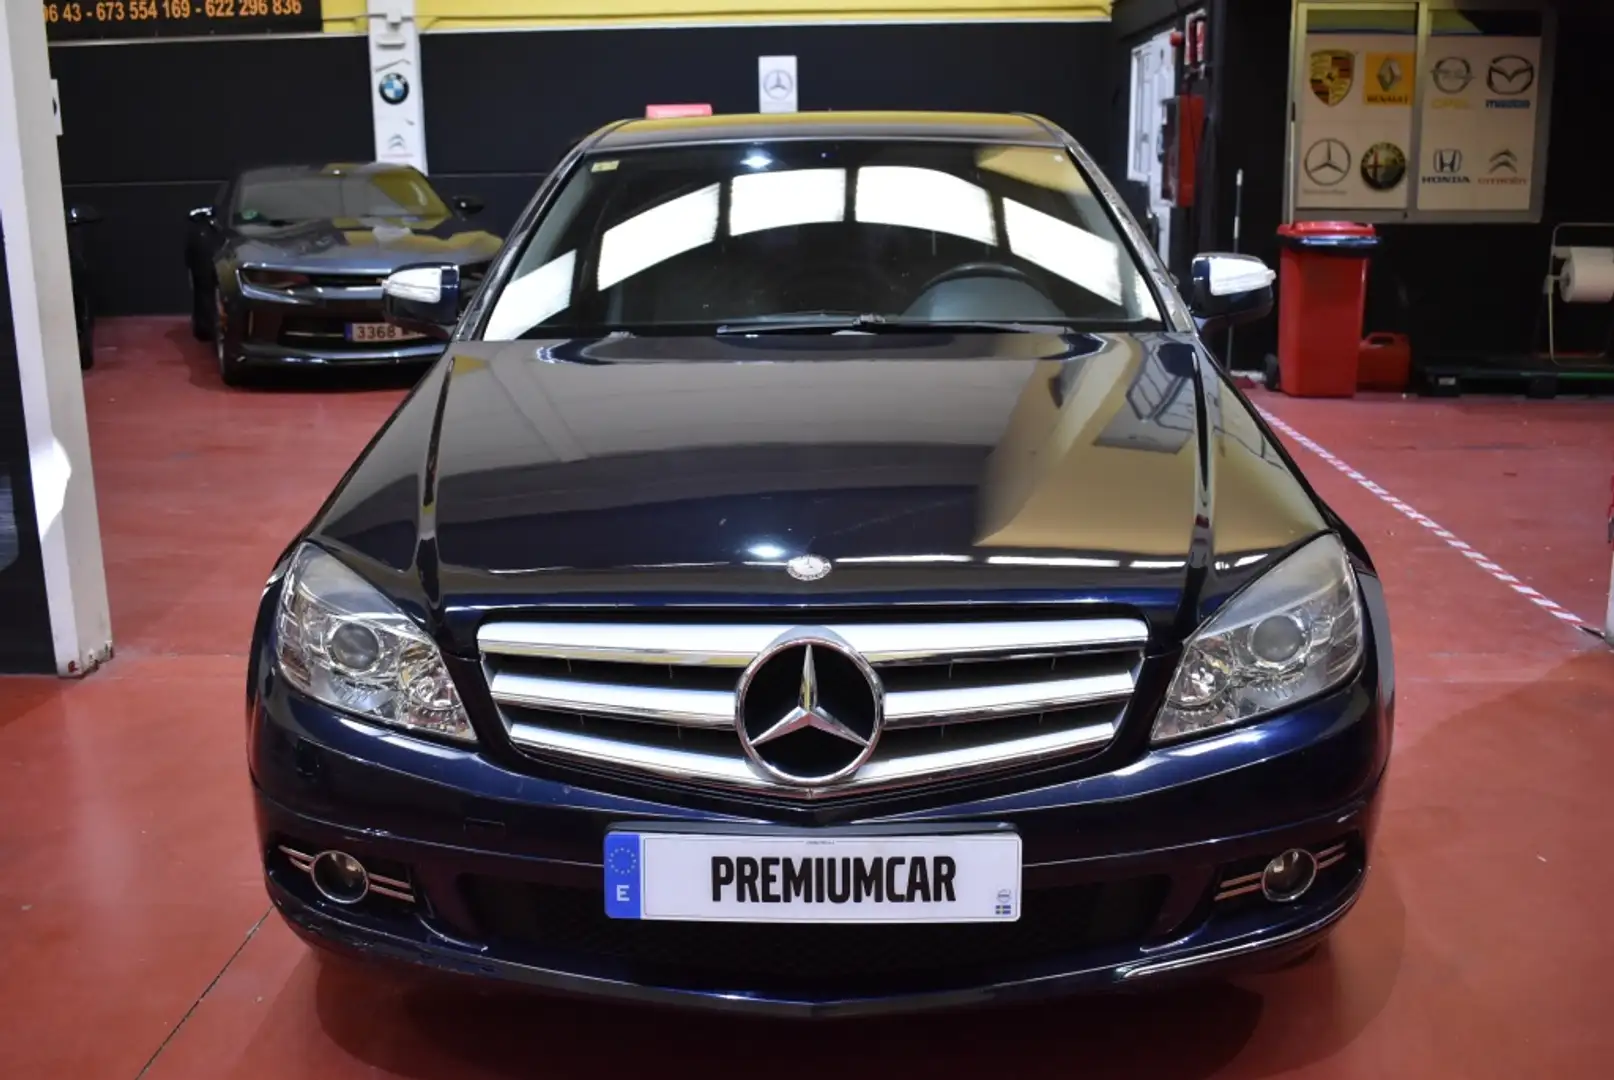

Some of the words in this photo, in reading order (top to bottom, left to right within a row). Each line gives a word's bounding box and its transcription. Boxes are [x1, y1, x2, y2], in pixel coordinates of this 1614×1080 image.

[63, 3, 82, 22] 43
[96, 2, 125, 21] 673
[129, 1, 158, 20] 554
[162, 0, 191, 18] 169
[205, 0, 235, 17] 622
[239, 0, 268, 16] 296
[272, 0, 302, 15] 836
[1421, 175, 1470, 184] HONDA
[357, 325, 396, 339] 3368
[711, 855, 957, 904] PREMIUMCAR
[616, 884, 630, 902] E
